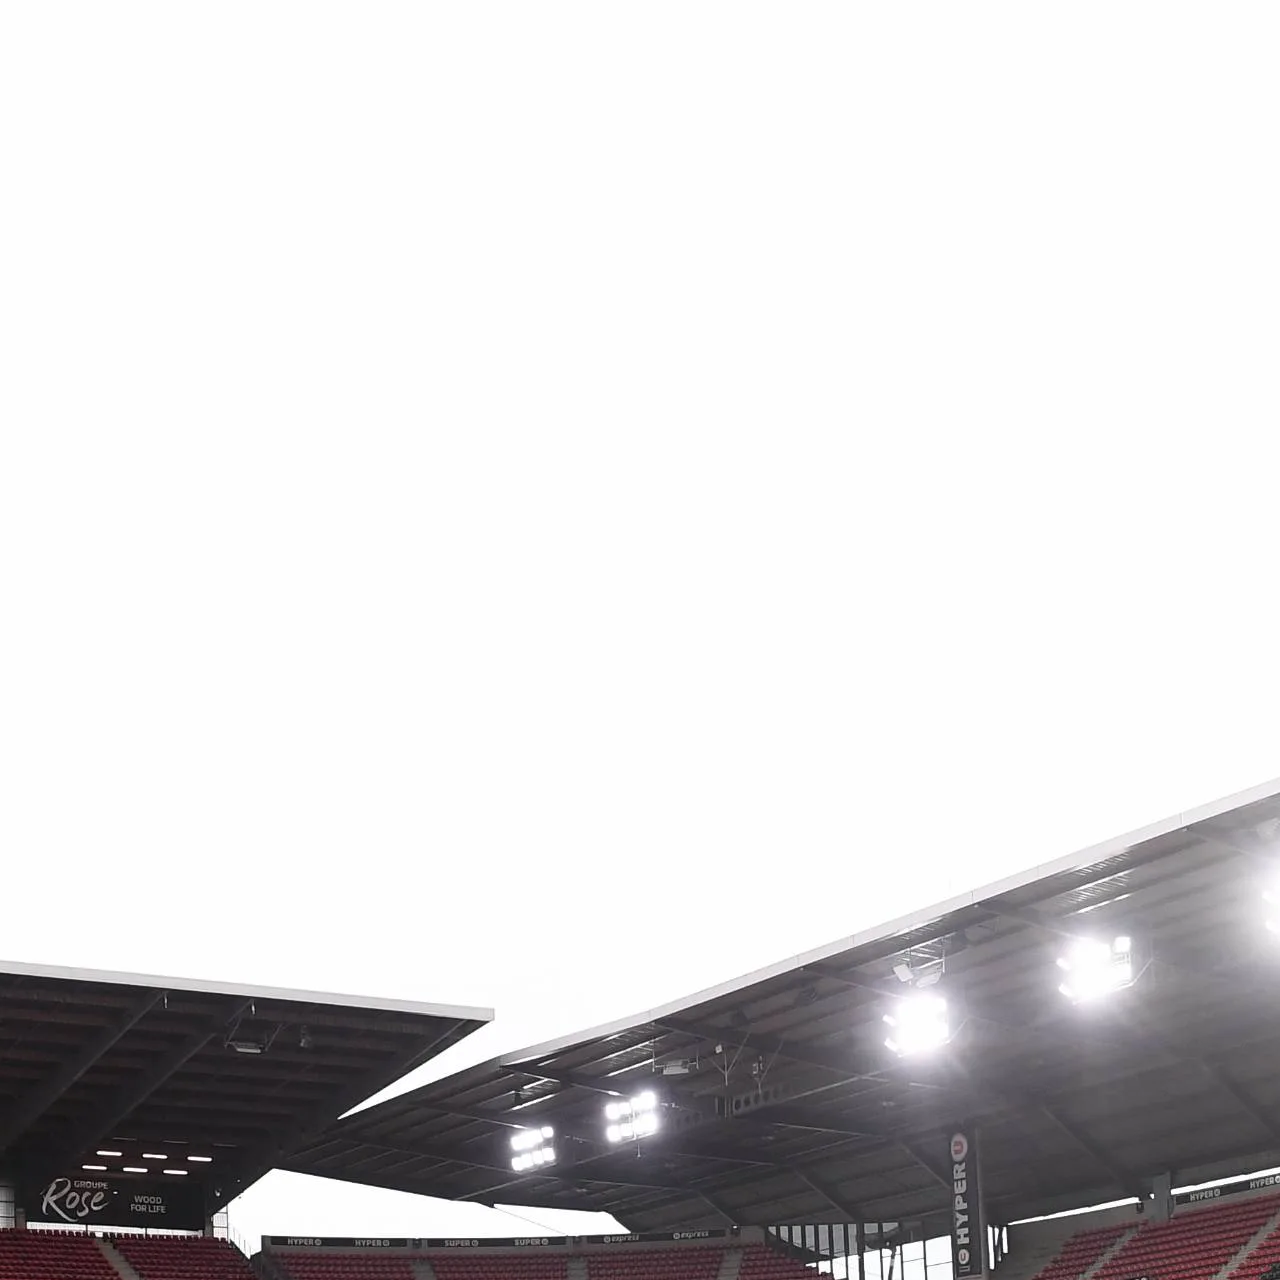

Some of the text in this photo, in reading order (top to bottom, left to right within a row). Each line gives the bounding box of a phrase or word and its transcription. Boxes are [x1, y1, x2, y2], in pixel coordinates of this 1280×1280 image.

[73, 1180, 108, 1190] GROUPE
[134, 1195, 162, 1204] WOOD
[953, 1162, 970, 1245] HYPER
[131, 1204, 166, 1213] FOR LIFE
